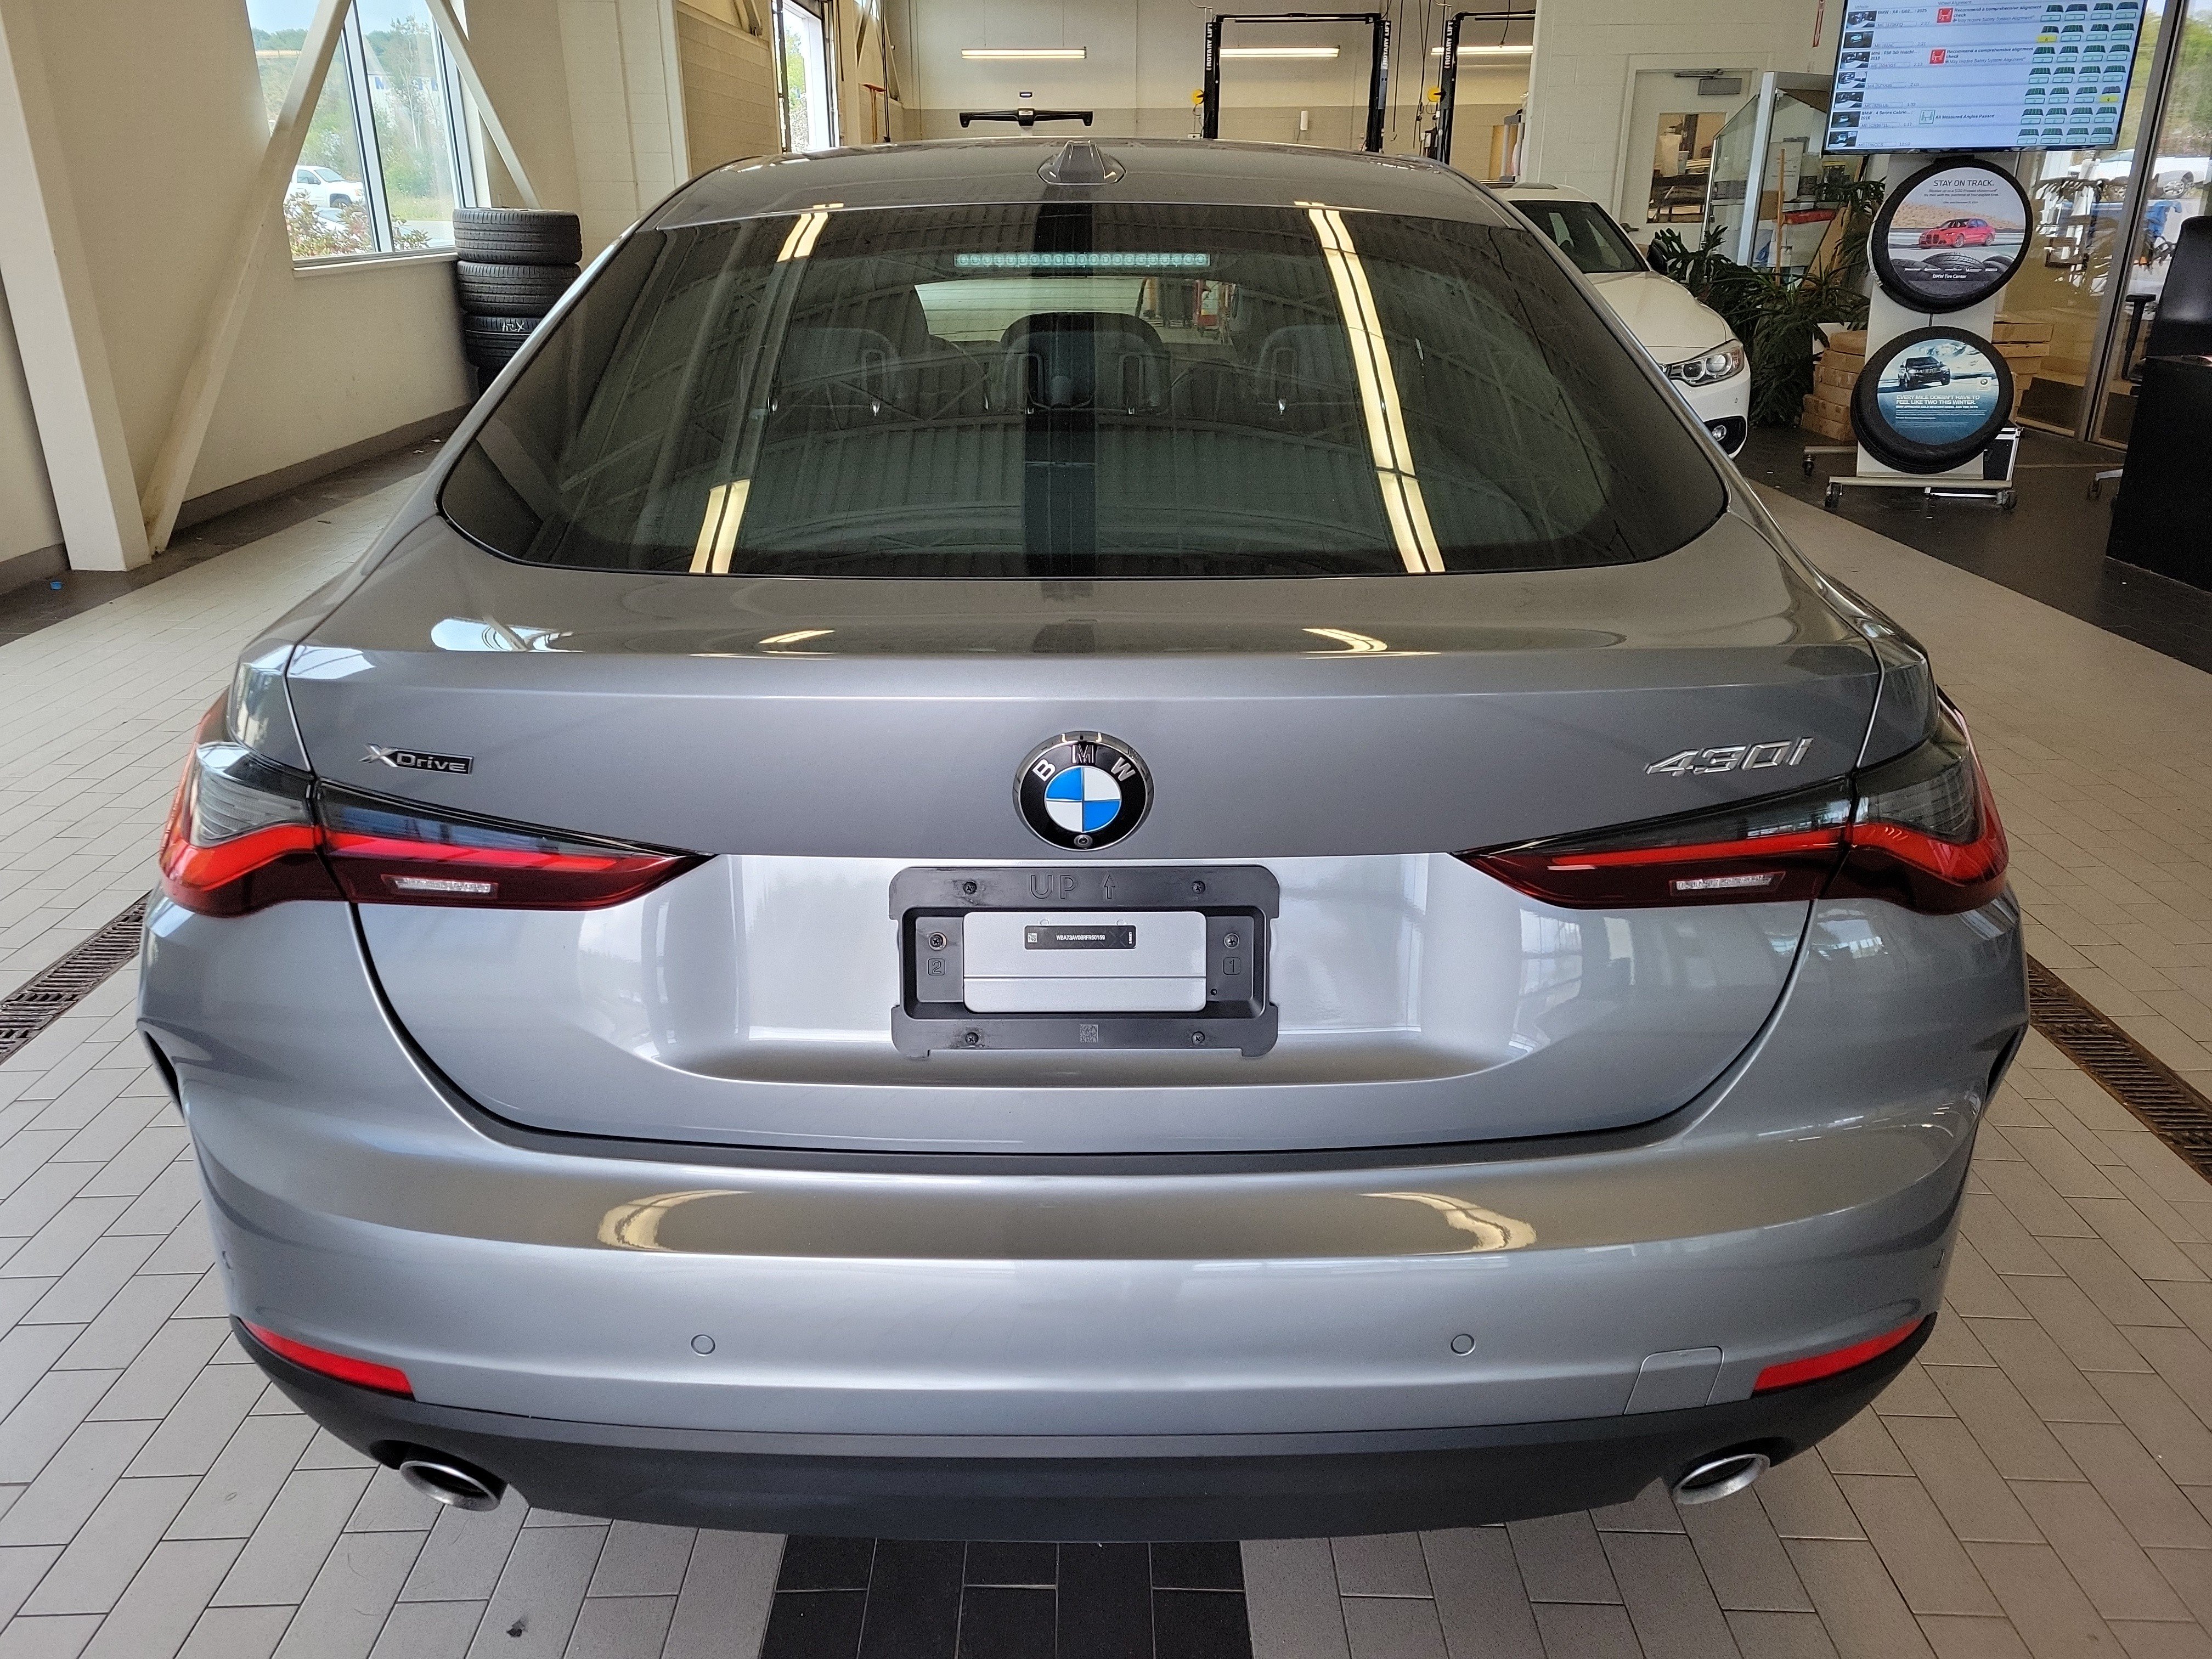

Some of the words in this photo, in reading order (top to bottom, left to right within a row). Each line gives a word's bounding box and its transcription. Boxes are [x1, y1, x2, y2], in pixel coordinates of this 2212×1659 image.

[1032, 744, 1136, 782] BMW
[1645, 737, 1813, 776] 430i
[1030, 874, 1077, 901] UP
[932, 960, 943, 974] 2
